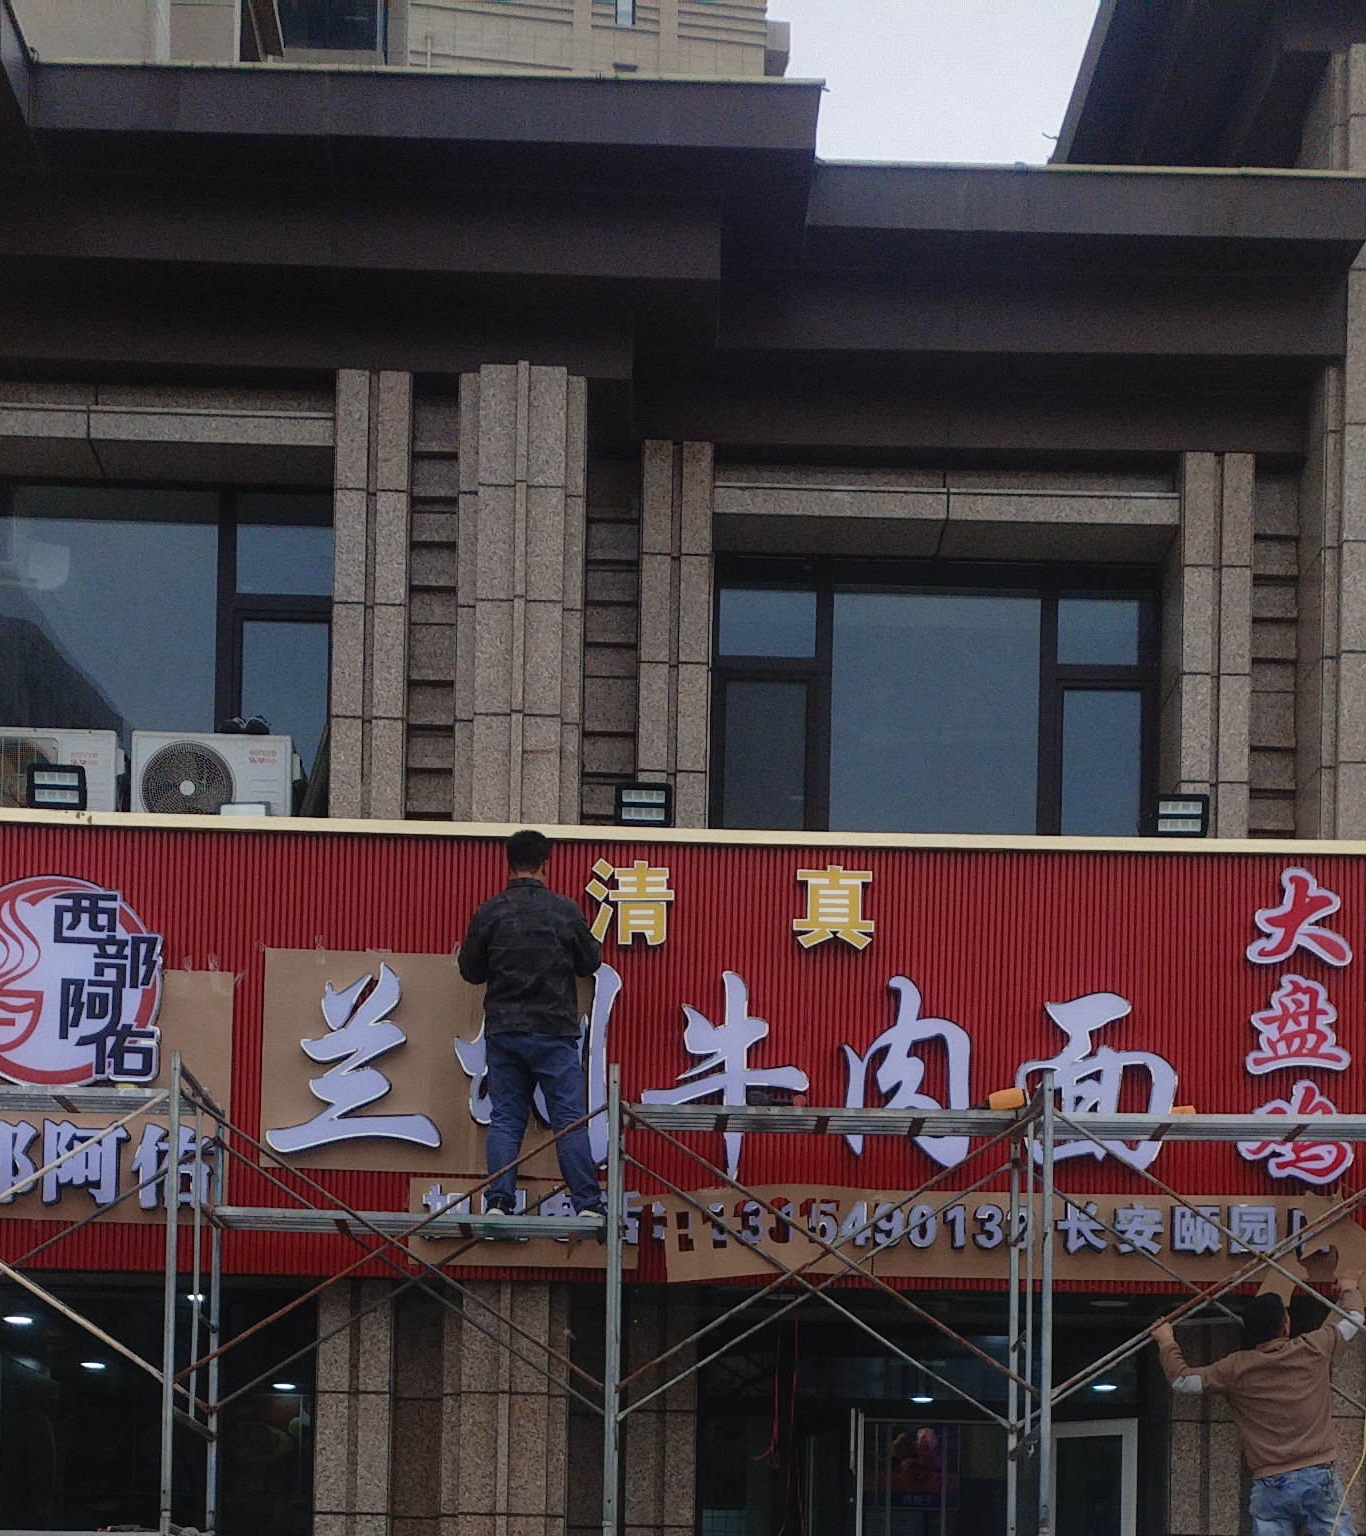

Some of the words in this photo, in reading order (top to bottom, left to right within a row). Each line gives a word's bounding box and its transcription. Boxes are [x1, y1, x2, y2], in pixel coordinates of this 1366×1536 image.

[53, 892, 163, 1078] 西部阿佑
[586, 858, 875, 950] 清真
[1237, 858, 1354, 1185] 大盘鸡
